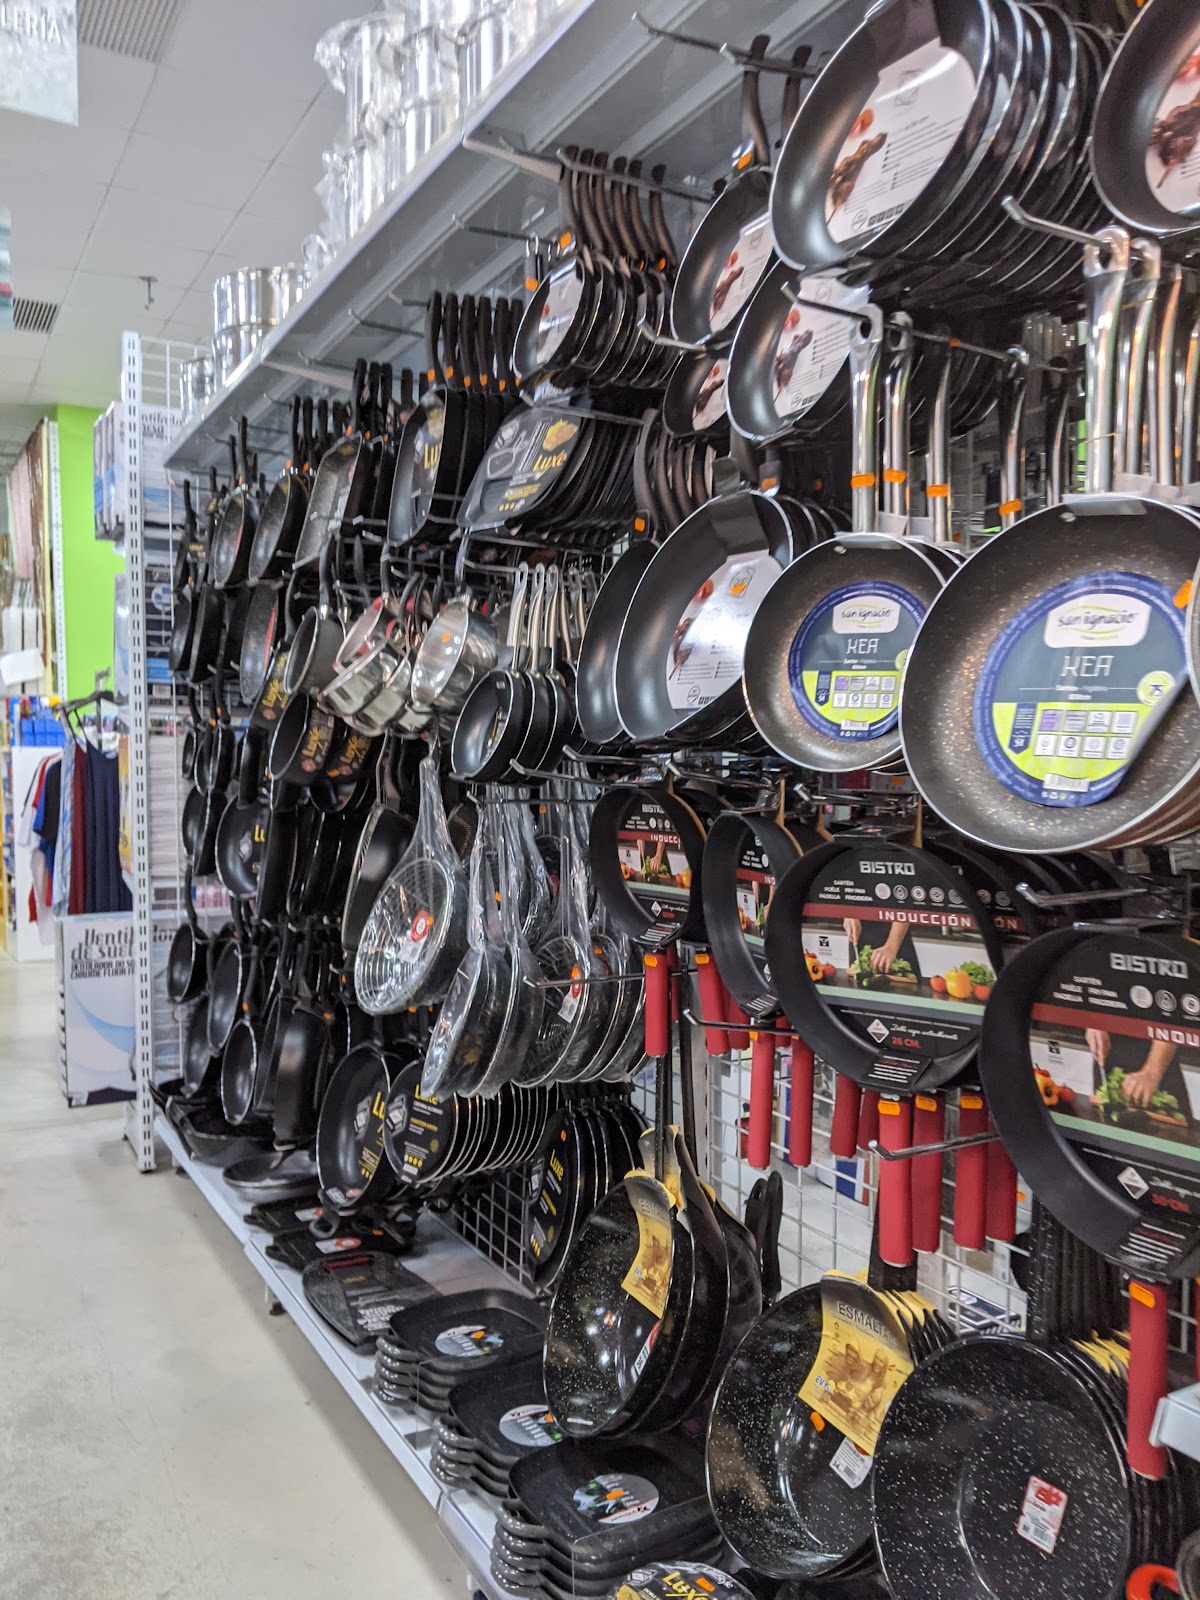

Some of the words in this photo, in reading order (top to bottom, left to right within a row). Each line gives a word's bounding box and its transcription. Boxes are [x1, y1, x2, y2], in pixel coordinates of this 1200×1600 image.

[532, 449, 568, 476] Luxe
[846, 638, 880, 655] KEA
[1060, 655, 1115, 677] KEA
[859, 860, 916, 876] BISTRO
[878, 910, 971, 927] INDUCCIÓN
[1110, 952, 1188, 980] BISTRO
[549, 1151, 564, 1182] Luxe
